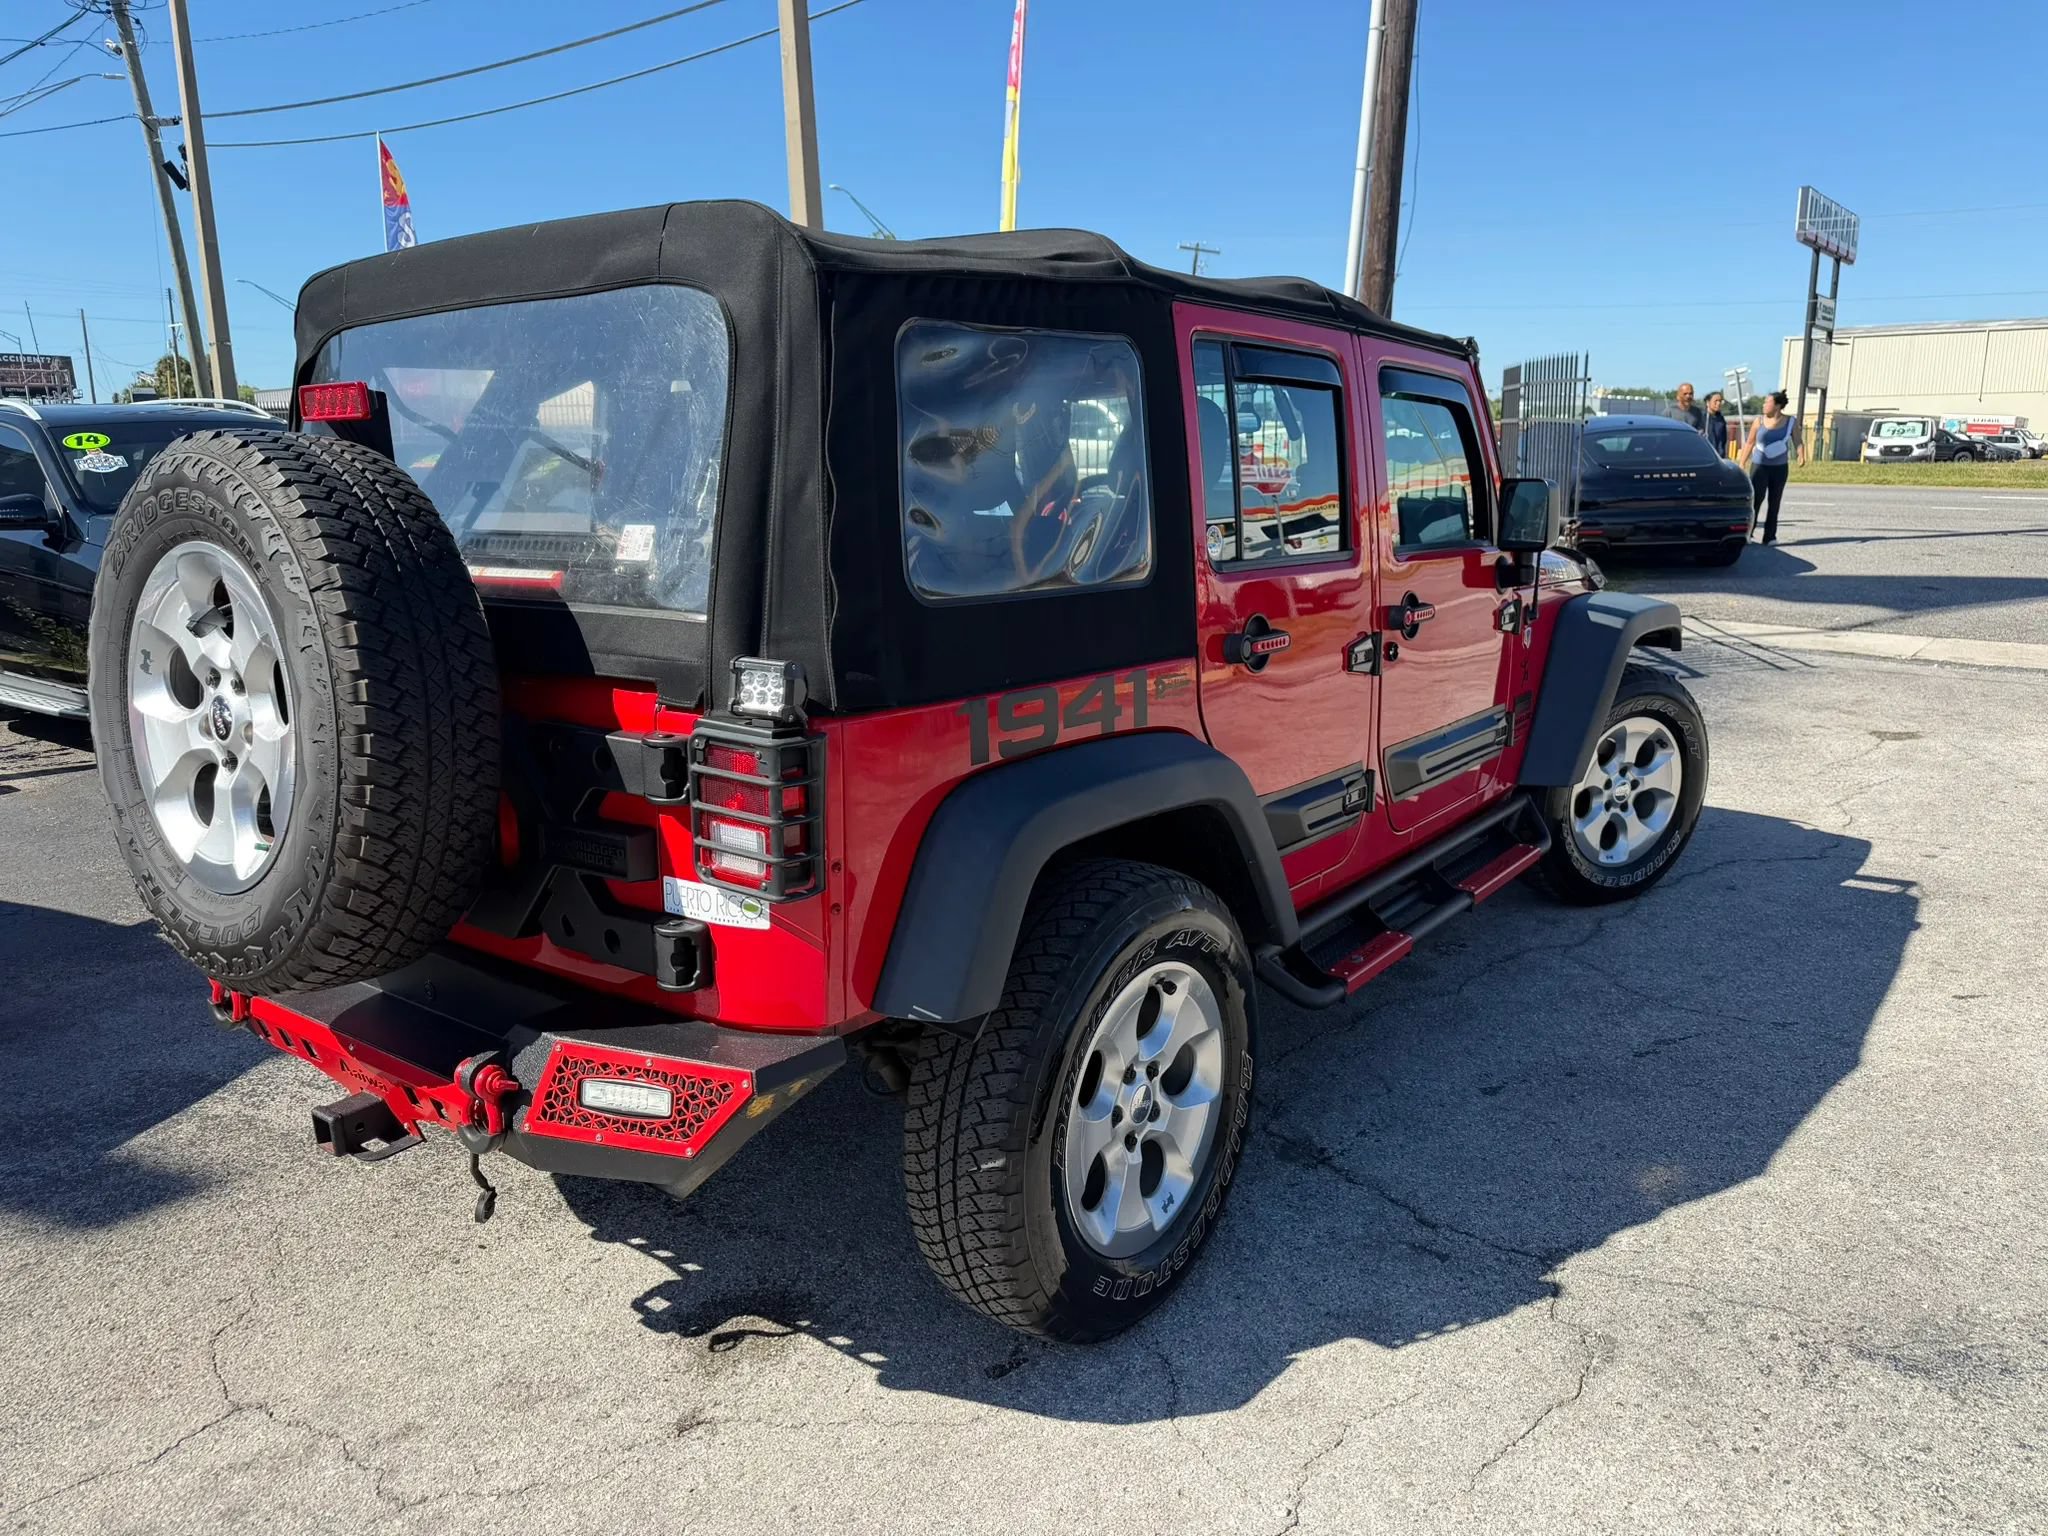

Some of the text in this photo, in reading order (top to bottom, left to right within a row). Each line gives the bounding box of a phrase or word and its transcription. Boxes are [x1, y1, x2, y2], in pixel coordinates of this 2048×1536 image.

[74, 434, 101, 447] 14
[111, 486, 272, 585] BRIDGESTONE
[956, 668, 1147, 767] 1941
[664, 881, 712, 913] PUERTO
[1165, 928, 1223, 953] A/T
[1092, 1049, 1255, 1301] BRIDGESTONE
